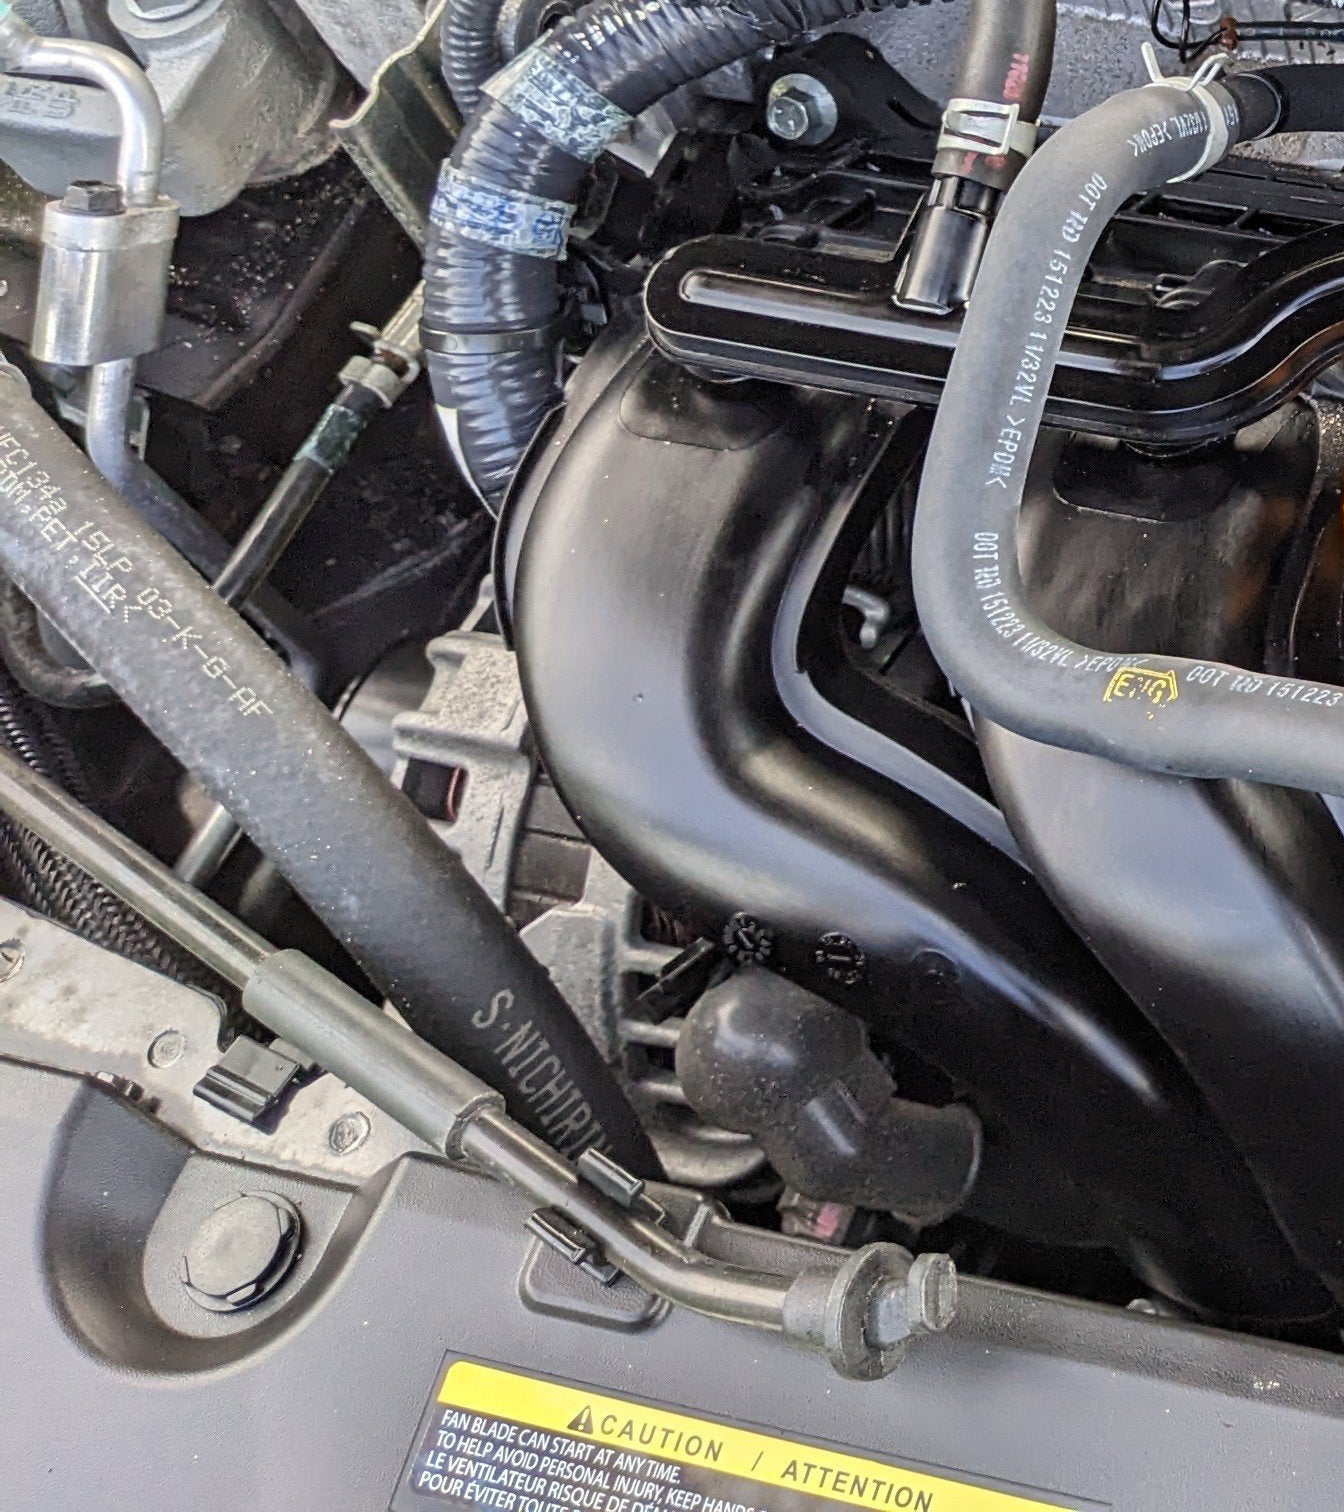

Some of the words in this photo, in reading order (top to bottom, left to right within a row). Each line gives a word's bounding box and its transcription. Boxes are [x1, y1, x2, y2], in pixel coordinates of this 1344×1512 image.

[1078, 172, 1108, 212] DOT
[1185, 664, 1231, 689] DOT
[1266, 680, 1340, 707] 151223
[437, 1430, 457, 1449] TO
[457, 1434, 494, 1458] HELP
[495, 1443, 540, 1470] AVOID
[539, 1454, 611, 1489] PERSONAL
[612, 1471, 664, 1505] INJURY,
[665, 1483, 702, 1509] KEEP
[441, 1409, 470, 1432] FAN
[472, 1418, 518, 1443] BLADE
[517, 1427, 551, 1452] CAN
[550, 1435, 593, 1461] START
[593, 1447, 616, 1466] AT
[615, 1452, 647, 1473] ANY
[648, 1459, 682, 1485] TIME.
[600, 1413, 724, 1463] CAUTION
[780, 1458, 935, 1512] ATTENTION
[418, 1470, 468, 1499] POUR
[467, 1478, 515, 1510] ÉVITER
[426, 1450, 446, 1469] LE
[447, 1455, 549, 1496] VENTILATEUR
[548, 1481, 605, 1512] RISQUE
